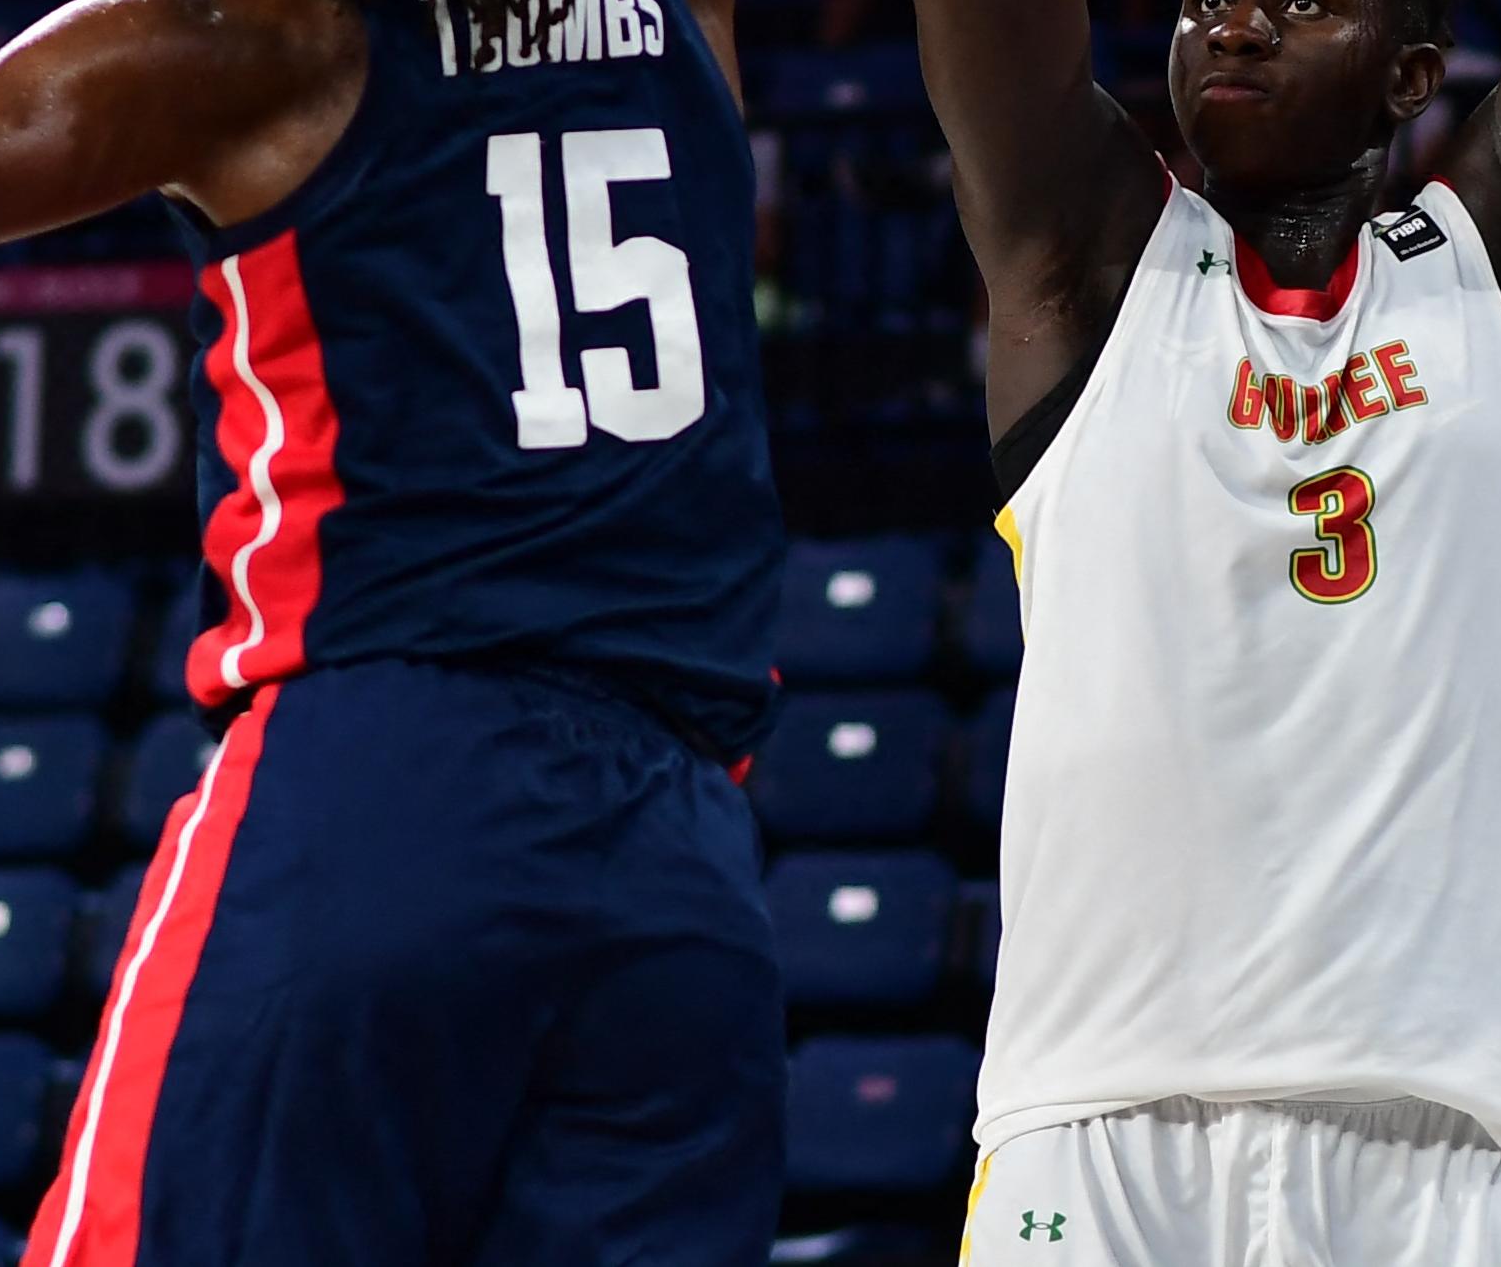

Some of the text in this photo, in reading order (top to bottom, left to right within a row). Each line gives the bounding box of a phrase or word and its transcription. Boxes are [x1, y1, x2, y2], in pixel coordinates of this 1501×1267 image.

[485, 128, 705, 448] 15
[1387, 217, 1427, 242] FIBA
[1288, 464, 1377, 604] 3
